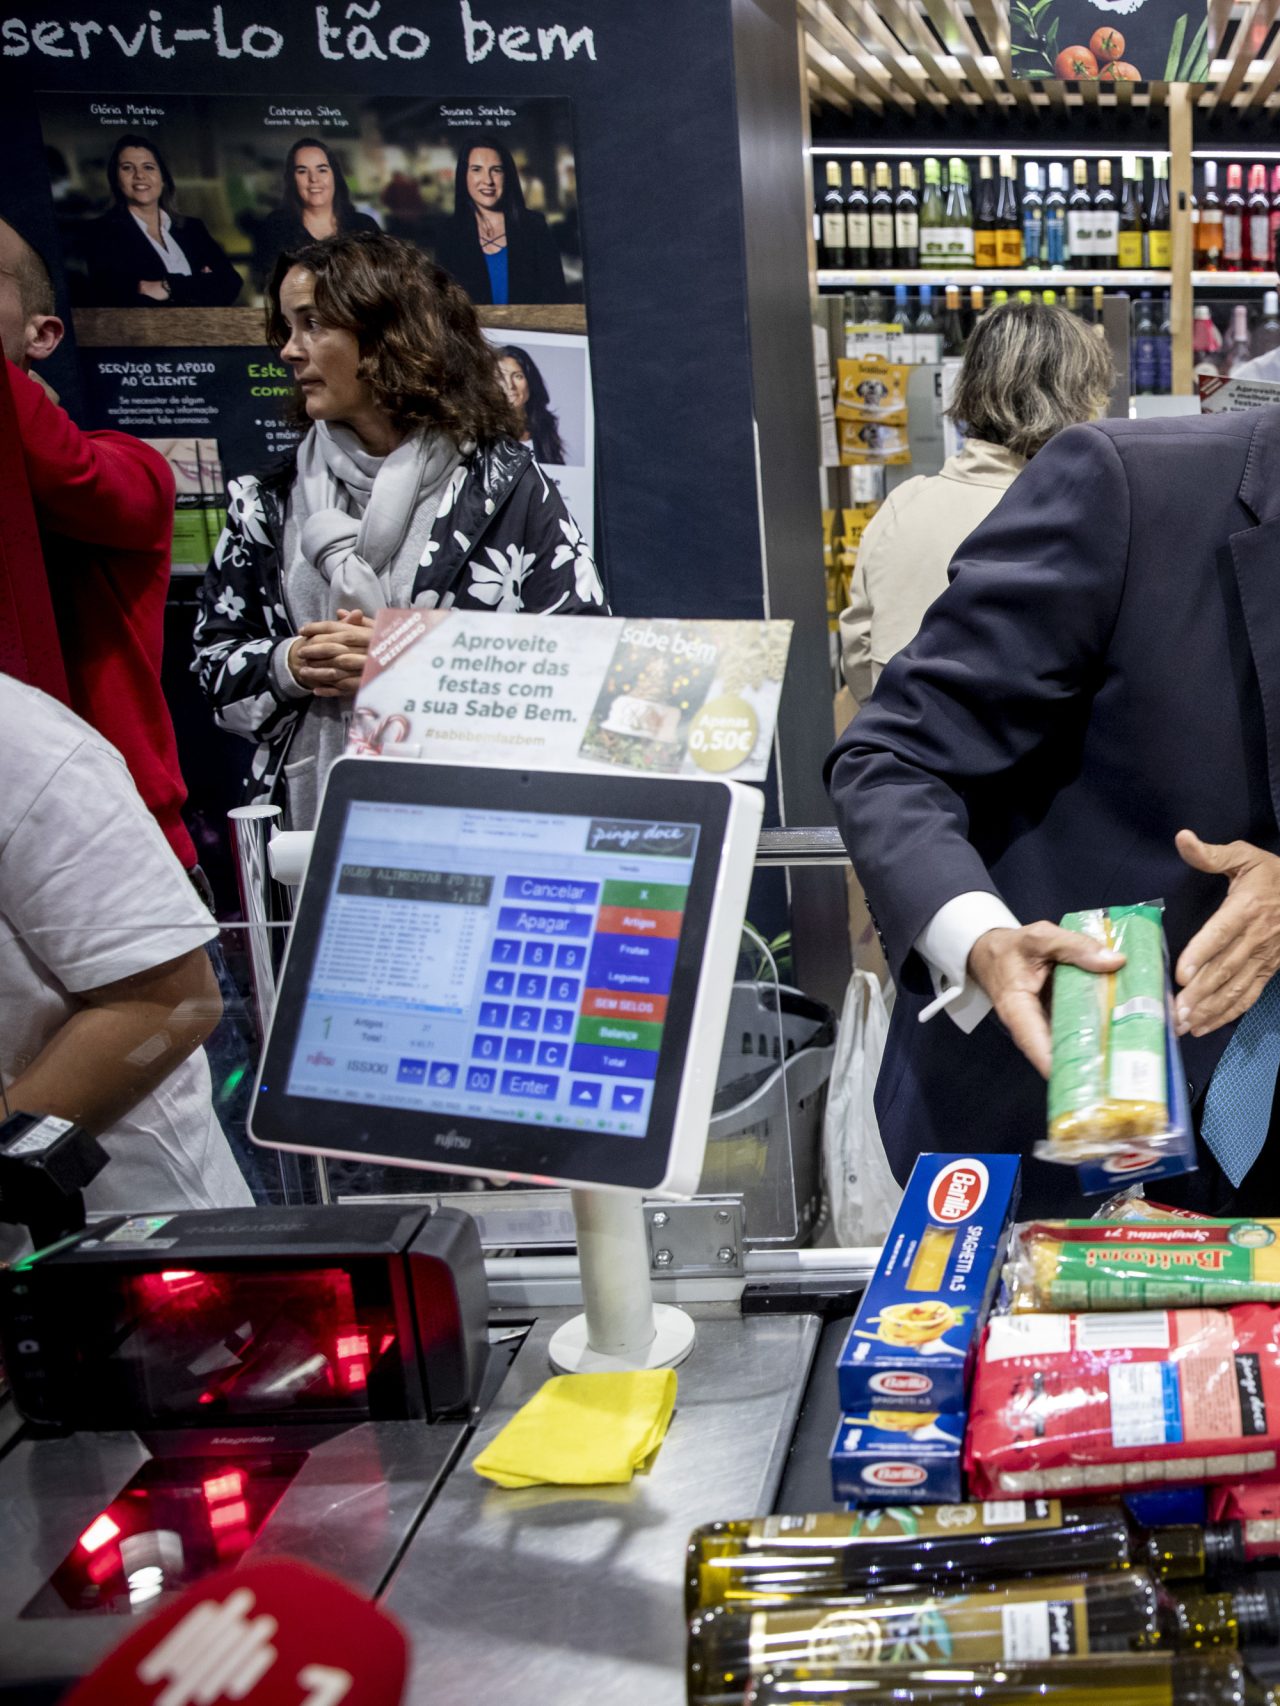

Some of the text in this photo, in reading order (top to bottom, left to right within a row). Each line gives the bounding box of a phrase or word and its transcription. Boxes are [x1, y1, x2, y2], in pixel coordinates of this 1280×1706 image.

[2, 0, 598, 63] servi-lo tão bem
[127, 105, 164, 115] Martins
[269, 106, 341, 116] Catarina Silva
[440, 106, 473, 116] Susana
[98, 362, 215, 378] SERVIÇO DE APOIO
[247, 362, 287, 378] Este
[121, 376, 197, 386] AO CLIENTE
[371, 612, 422, 658] NOVEMBRO
[379, 624, 426, 666] DEZEMBRO
[452, 632, 557, 653] Aproveite
[621, 625, 717, 663] sabe bem
[432, 656, 569, 677] o melhor das
[438, 675, 553, 698] festas com
[404, 700, 577, 723] a sua Sabe Bem.
[699, 716, 749, 729] Apenas
[690, 729, 752, 752] 0,50€
[591, 824, 685, 849] pingo doce
[521, 880, 585, 899] Cancelar
[516, 912, 571, 933] Apagar
[622, 916, 657, 931] Artigos
[502, 944, 576, 966] 7 8 9
[619, 944, 650, 957] Frutas
[494, 976, 569, 998] 4 5 6
[608, 971, 650, 985] Legumes
[489, 1009, 563, 1031] 1 2 3
[482, 1040, 557, 1063] 0 C
[603, 1056, 627, 1068] Total
[471, 1072, 549, 1095] 00 Enter
[435, 1129, 472, 1150] FUJITSU
[939, 1171, 977, 1220] Barilla
[1127, 1229, 1210, 1243] Spaghettini
[955, 1225, 984, 1274] SPAGHETTI
[1085, 1247, 1232, 1270] Buitoni
[883, 1375, 927, 1390] Barilla
[210, 1436, 276, 1445] Magellan
[877, 1466, 922, 1481] Barilla
